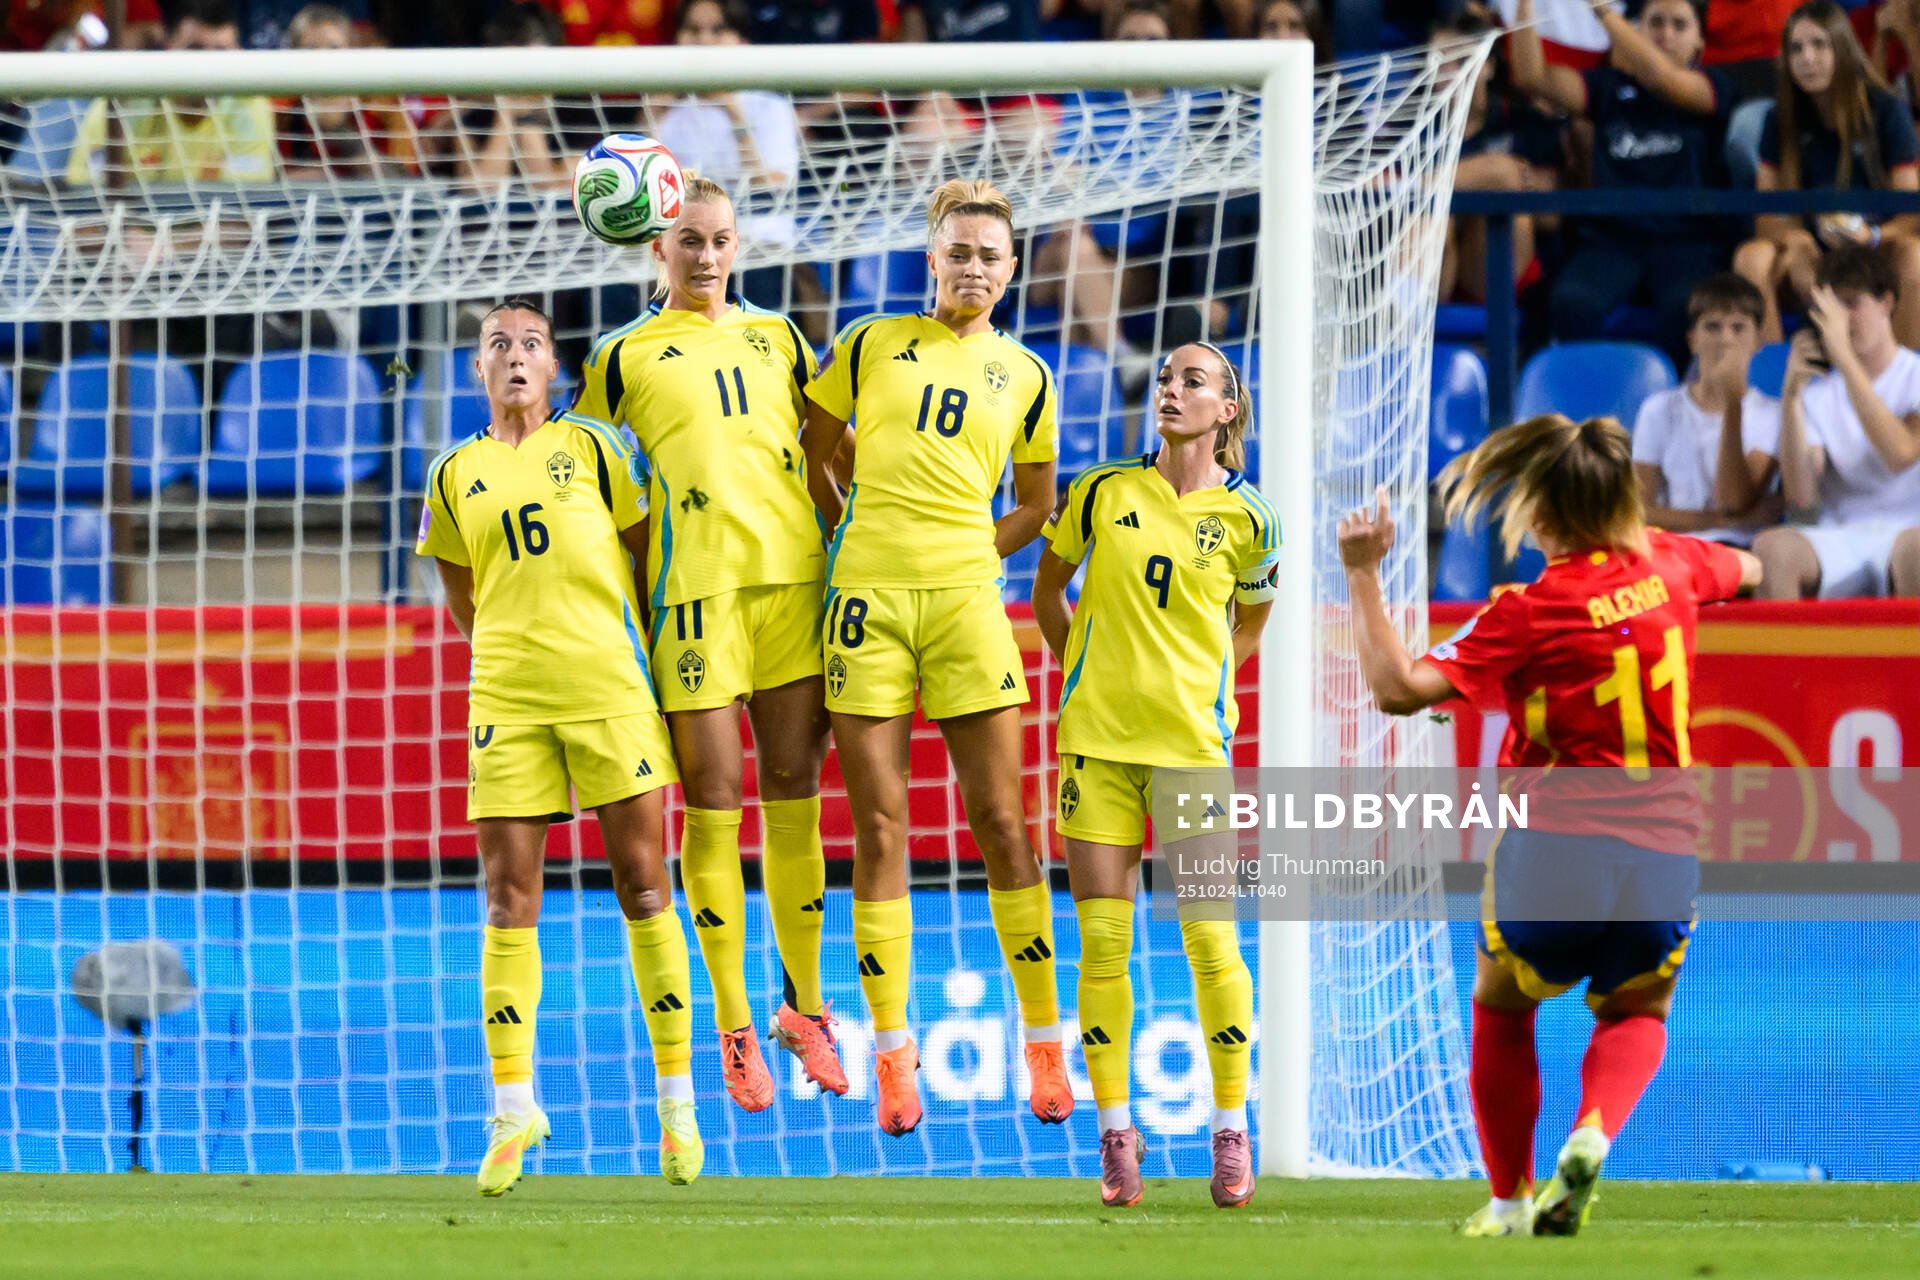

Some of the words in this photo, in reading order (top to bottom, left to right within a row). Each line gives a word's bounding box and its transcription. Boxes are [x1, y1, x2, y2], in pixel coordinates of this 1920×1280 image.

[714, 366, 749, 417] 11
[916, 384, 968, 438] 18
[501, 502, 550, 561] 16
[1145, 554, 1173, 609] 9
[1586, 574, 1670, 629] ALEXIA
[676, 599, 703, 641] 11
[828, 594, 868, 648] 18
[1594, 624, 1693, 782] 11
